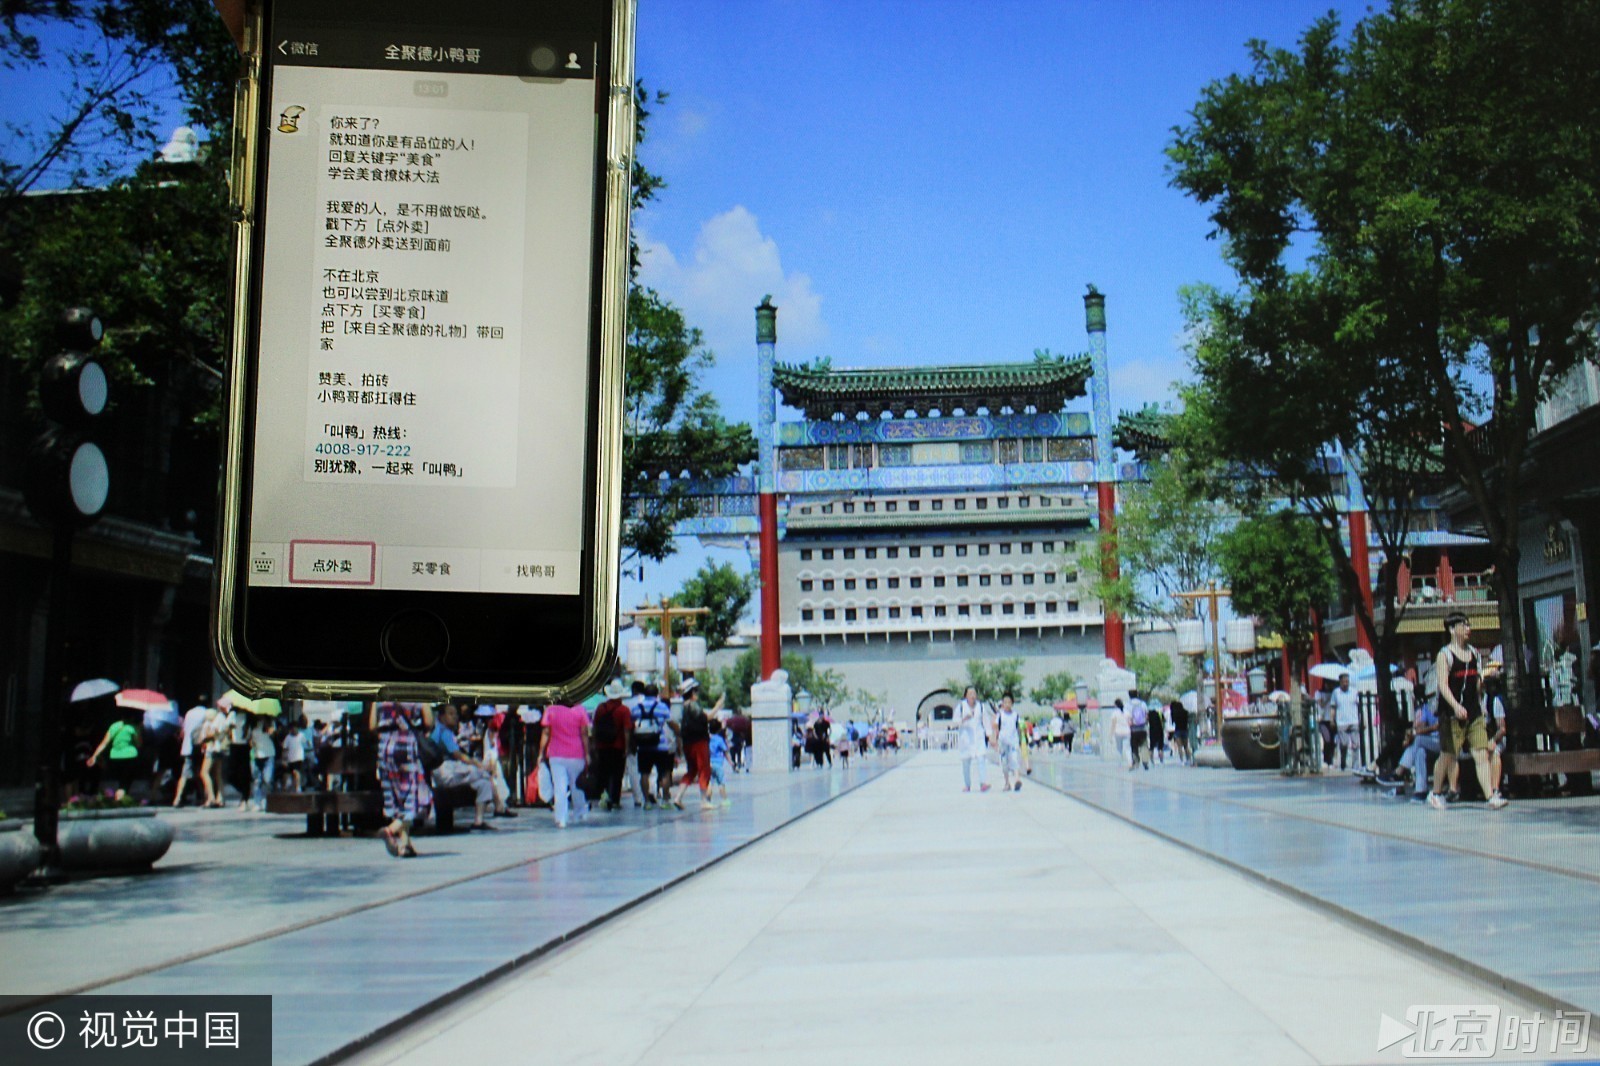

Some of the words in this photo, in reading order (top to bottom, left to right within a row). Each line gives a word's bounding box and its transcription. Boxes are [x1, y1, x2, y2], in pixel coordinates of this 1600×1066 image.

[291, 42, 319, 56] 微信
[384, 44, 481, 64] 全聚德小鸭哥
[330, 116, 380, 130] 你来了?
[329, 133, 475, 151] 就知道你是有品位的人!
[328, 167, 440, 184] 学会美食撩妹大法
[325, 235, 451, 252] 全聚德外卖送到面前
[323, 269, 379, 283] 不在北京
[322, 286, 448, 303] 也可以尝到北京味道
[320, 337, 334, 350] 家
[318, 371, 389, 387] 赞美、拍砖
[317, 389, 417, 405] 小鸭哥都扛得住
[315, 443, 411, 457] 4008-917-222
[312, 559, 352, 573] 点外卖
[411, 561, 451, 576] 买零食
[517, 564, 556, 578] 找鸭哥
